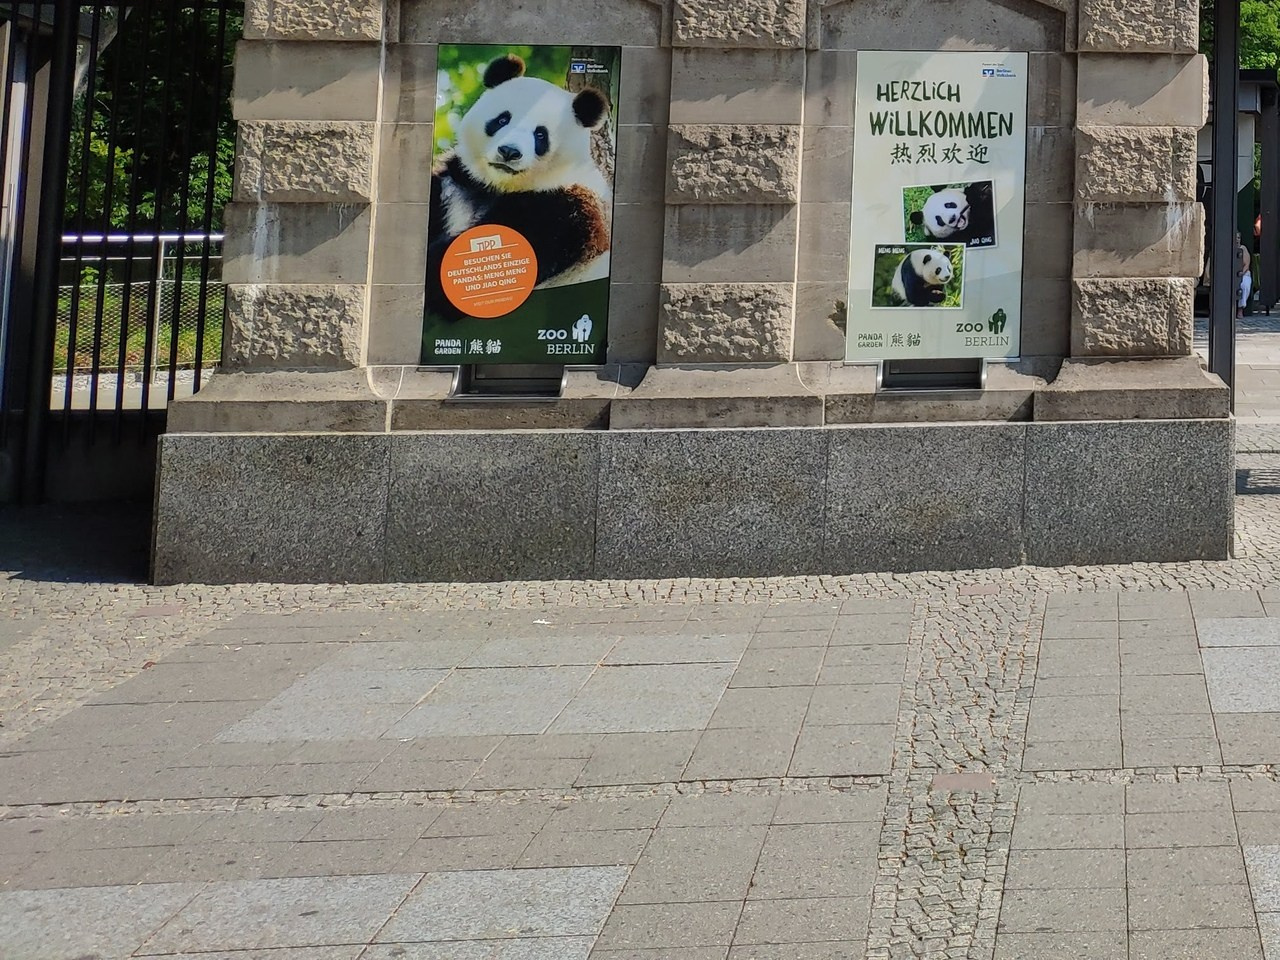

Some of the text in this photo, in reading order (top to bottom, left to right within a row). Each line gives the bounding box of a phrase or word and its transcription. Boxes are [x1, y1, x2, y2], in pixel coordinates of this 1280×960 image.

[890, 142, 990, 165] 热烈欢迎
[476, 239, 496, 250] TIPP
[463, 252, 512, 266] BESUCHEN SIE
[447, 257, 530, 277] DEUTSCHLANDS EINZIGE
[453, 266, 527, 285] PANDAS: MENG MENG
[465, 277, 517, 292] UND JIAO QING
[956, 323, 984, 333] ZOO
[537, 329, 568, 340] ZOO
[435, 339, 462, 347] PANDA
[964, 336, 1009, 347] BERLIN
[546, 343, 596, 355] BERLIN
